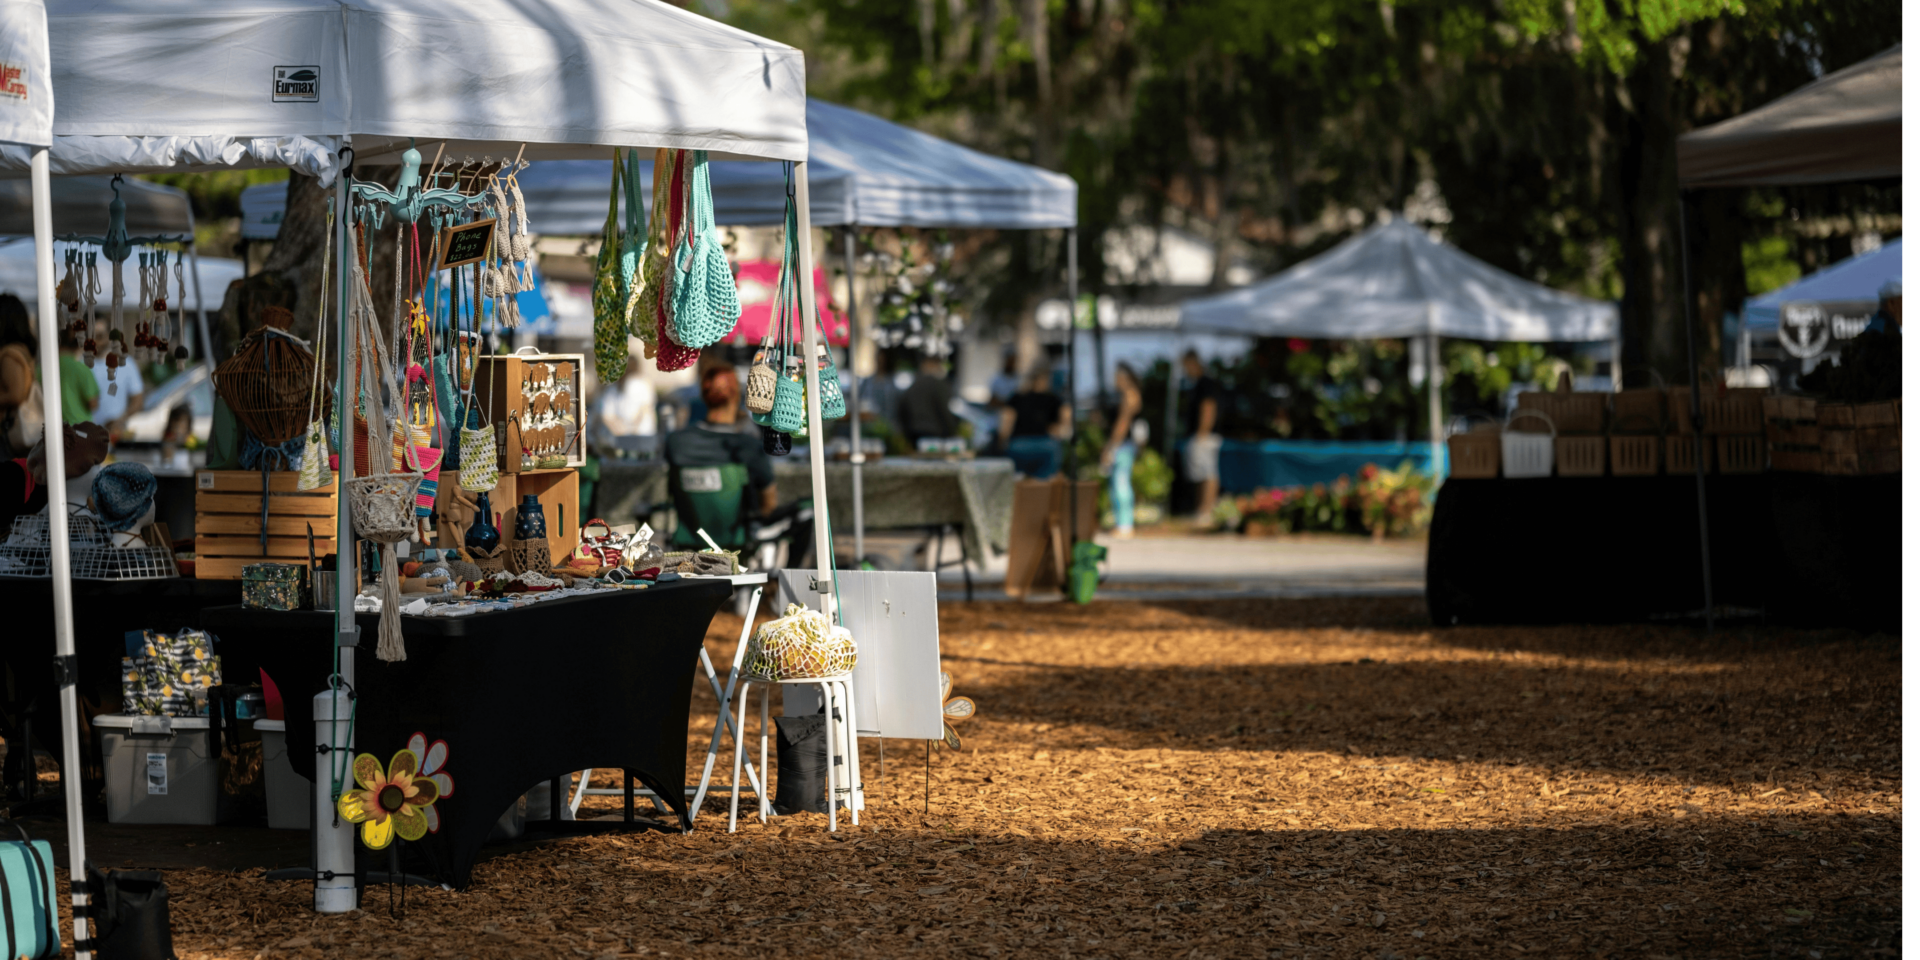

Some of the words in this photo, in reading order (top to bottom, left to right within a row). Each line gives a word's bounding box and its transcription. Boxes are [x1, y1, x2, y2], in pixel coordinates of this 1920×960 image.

[275, 79, 315, 94] Eurmax
[455, 231, 482, 243] Phone
[455, 243, 477, 253] Bags
